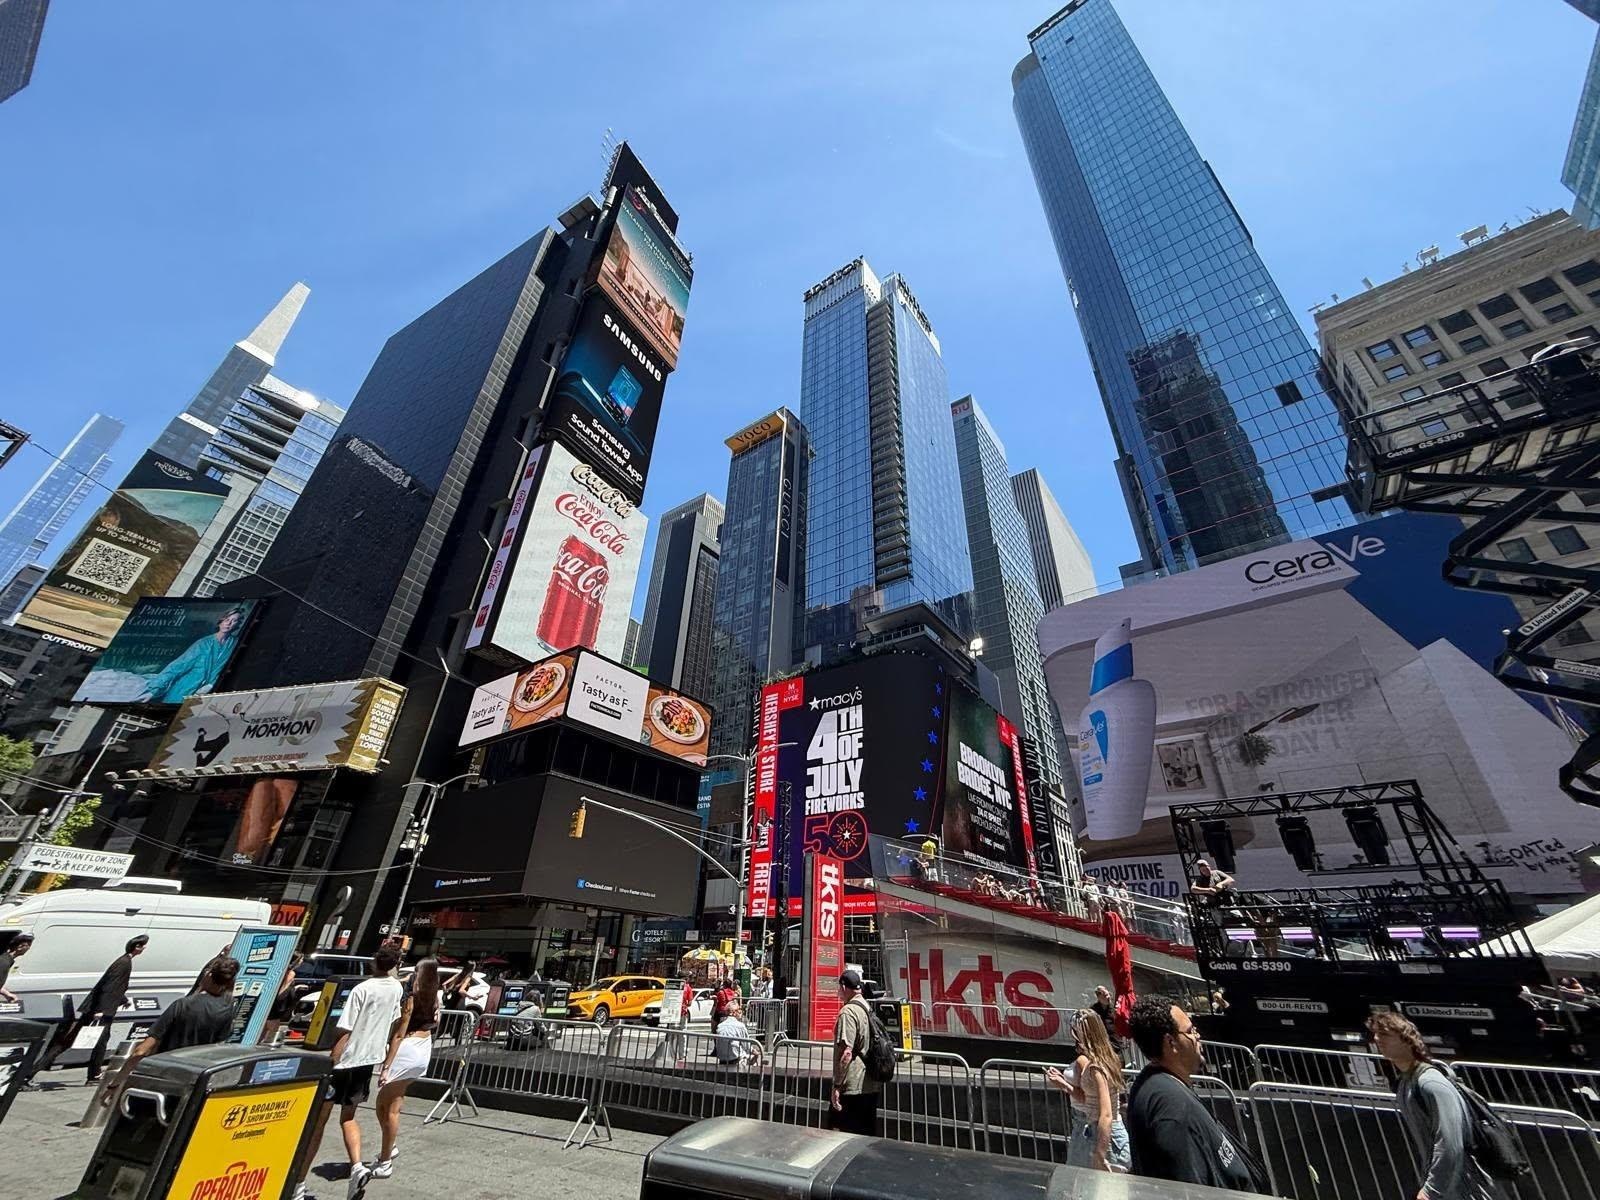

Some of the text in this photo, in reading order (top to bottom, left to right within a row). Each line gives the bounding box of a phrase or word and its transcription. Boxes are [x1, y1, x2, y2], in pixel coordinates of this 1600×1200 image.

[603, 313, 662, 381] SAMSUNG
[951, 403, 969, 417] RIU
[571, 413, 643, 482] Sound Tower App
[592, 419, 631, 459] Samsung
[1387, 432, 1465, 458] Genie GS-5390
[579, 493, 604, 518] Enjoy
[781, 478, 792, 539] GUCCI
[102, 521, 162, 548] LONG-TERM VISA
[555, 493, 631, 557] Coca-Cola
[96, 525, 107, 533] UP
[138, 542, 160, 554] YEARS
[1244, 534, 1387, 584] CeraVe
[60, 582, 120, 605] APPLY NOW!
[129, 615, 186, 627] Cornwell
[140, 604, 185, 616] Patricia
[1532, 591, 1585, 627] United Rentals
[582, 681, 609, 703] Tasty
[608, 693, 621, 707] as
[1255, 669, 1379, 701] STRONGER
[820, 686, 863, 710] macy's
[371, 708, 395, 720] SOUTH
[371, 716, 391, 727] PARK
[471, 707, 488, 719] Tasty
[488, 705, 496, 714] as
[242, 720, 316, 740] MORMON
[360, 733, 386, 745] ROBERT
[360, 741, 383, 754] LOPEZ
[760, 692, 779, 794] HERSHEY'S STORE
[837, 732, 864, 762] OF
[959, 741, 1007, 789] BROOKLYN
[805, 758, 864, 799] JULY
[957, 760, 1013, 811] BRIDGE, NYC
[804, 791, 865, 816] FIREWORKS
[803, 809, 868, 861] 50
[35, 847, 128, 866] PEDESTRIAN FLOW ZONE
[71, 861, 124, 875] KEEP MOVING
[753, 862, 770, 894] FREE
[1101, 862, 1165, 882] ROUTINE
[819, 861, 840, 940] tkts
[1149, 880, 1180, 899] OLD
[1209, 961, 1292, 972] Genie GS-5390
[899, 948, 1061, 1041] tkts
[1262, 1002, 1323, 1011] 800-UR-RENTS
[1421, 1007, 1452, 1016] United
[223, 1105, 248, 1127] #1
[247, 1113, 265, 1124] SHOW
[273, 1110, 288, 1119] 2025
[250, 1100, 291, 1115] BROADWAY
[190, 1167, 270, 1200] OPERATION
